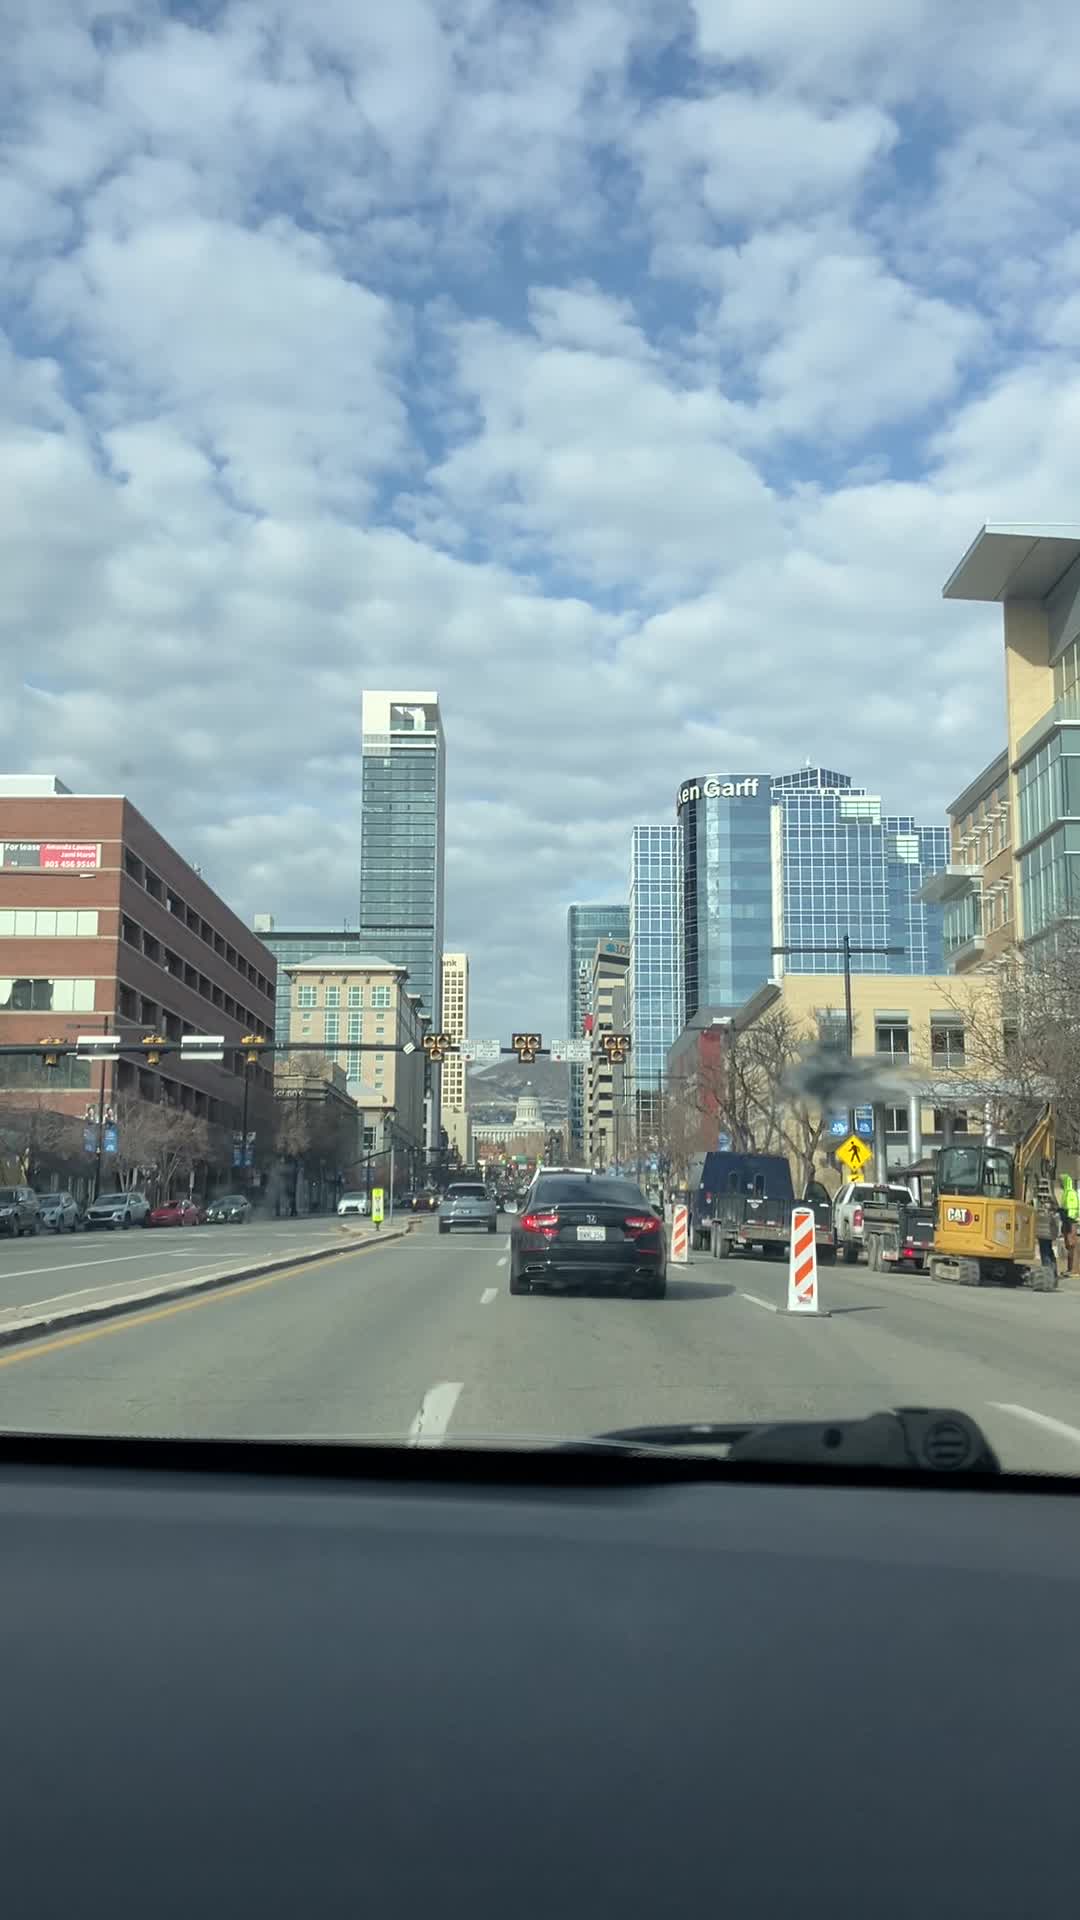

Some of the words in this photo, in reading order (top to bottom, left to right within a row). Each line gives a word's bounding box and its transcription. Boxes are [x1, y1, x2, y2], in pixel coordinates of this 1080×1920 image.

[703, 778, 759, 798] Garff
[45, 860, 59, 868] 801
[76, 860, 96, 868] 9510
[947, 1208, 968, 1223] CAT
